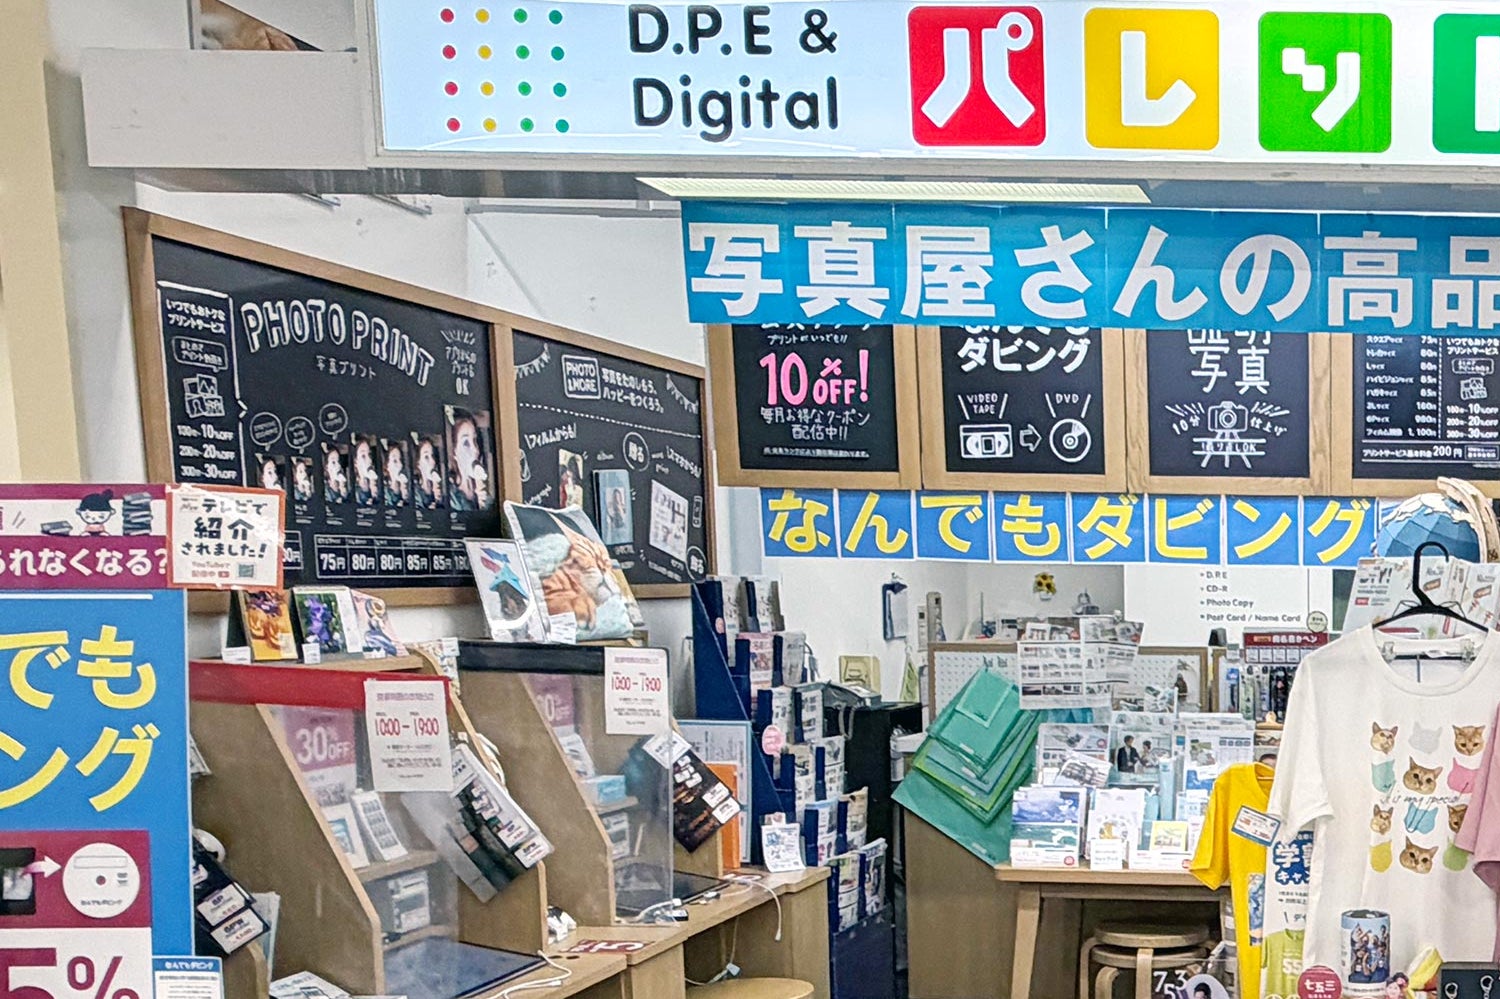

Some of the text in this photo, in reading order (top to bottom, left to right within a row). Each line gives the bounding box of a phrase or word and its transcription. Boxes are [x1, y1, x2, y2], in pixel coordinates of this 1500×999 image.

[629, 5, 837, 55] D.P.E &
[632, 77, 838, 142] Digital
[168, 313, 226, 335] プリントサービス
[240, 299, 435, 387] PHOTO PRINT
[1447, 347, 1499, 355] プリントサービス
[957, 336, 1091, 374] ダビング
[316, 355, 377, 380] 写真プリント
[566, 361, 596, 377] PHOTO
[1188, 345, 1270, 395] 写真
[455, 377, 470, 396] OK
[966, 392, 999, 404] VIDEO
[1055, 393, 1080, 404] DVD
[760, 407, 871, 426] 毎月お得なクーポン
[972, 404, 996, 415] TAPE
[1172, 415, 1201, 435] 10分
[1250, 416, 1288, 437] 仕上げ
[202, 497, 268, 516] テレビで
[194, 516, 255, 541] 紹介
[768, 489, 1372, 562] なんでもダビング
[181, 541, 267, 558] されました!
[319, 552, 346, 571] 75円
[351, 554, 376, 571] 80円
[406, 554, 428, 571] 85円
[1206, 585, 1228, 593] CD-R
[1206, 598, 1254, 608] Photo Copy
[1206, 614, 1224, 622] Post
[1226, 614, 1245, 622] Card
[1255, 614, 1279, 622] Name
[1283, 614, 1301, 622] Card
[375, 717, 401, 736] 10:00
[414, 717, 440, 736] 19:00
[1303, 978, 1336, 993] 七五三
